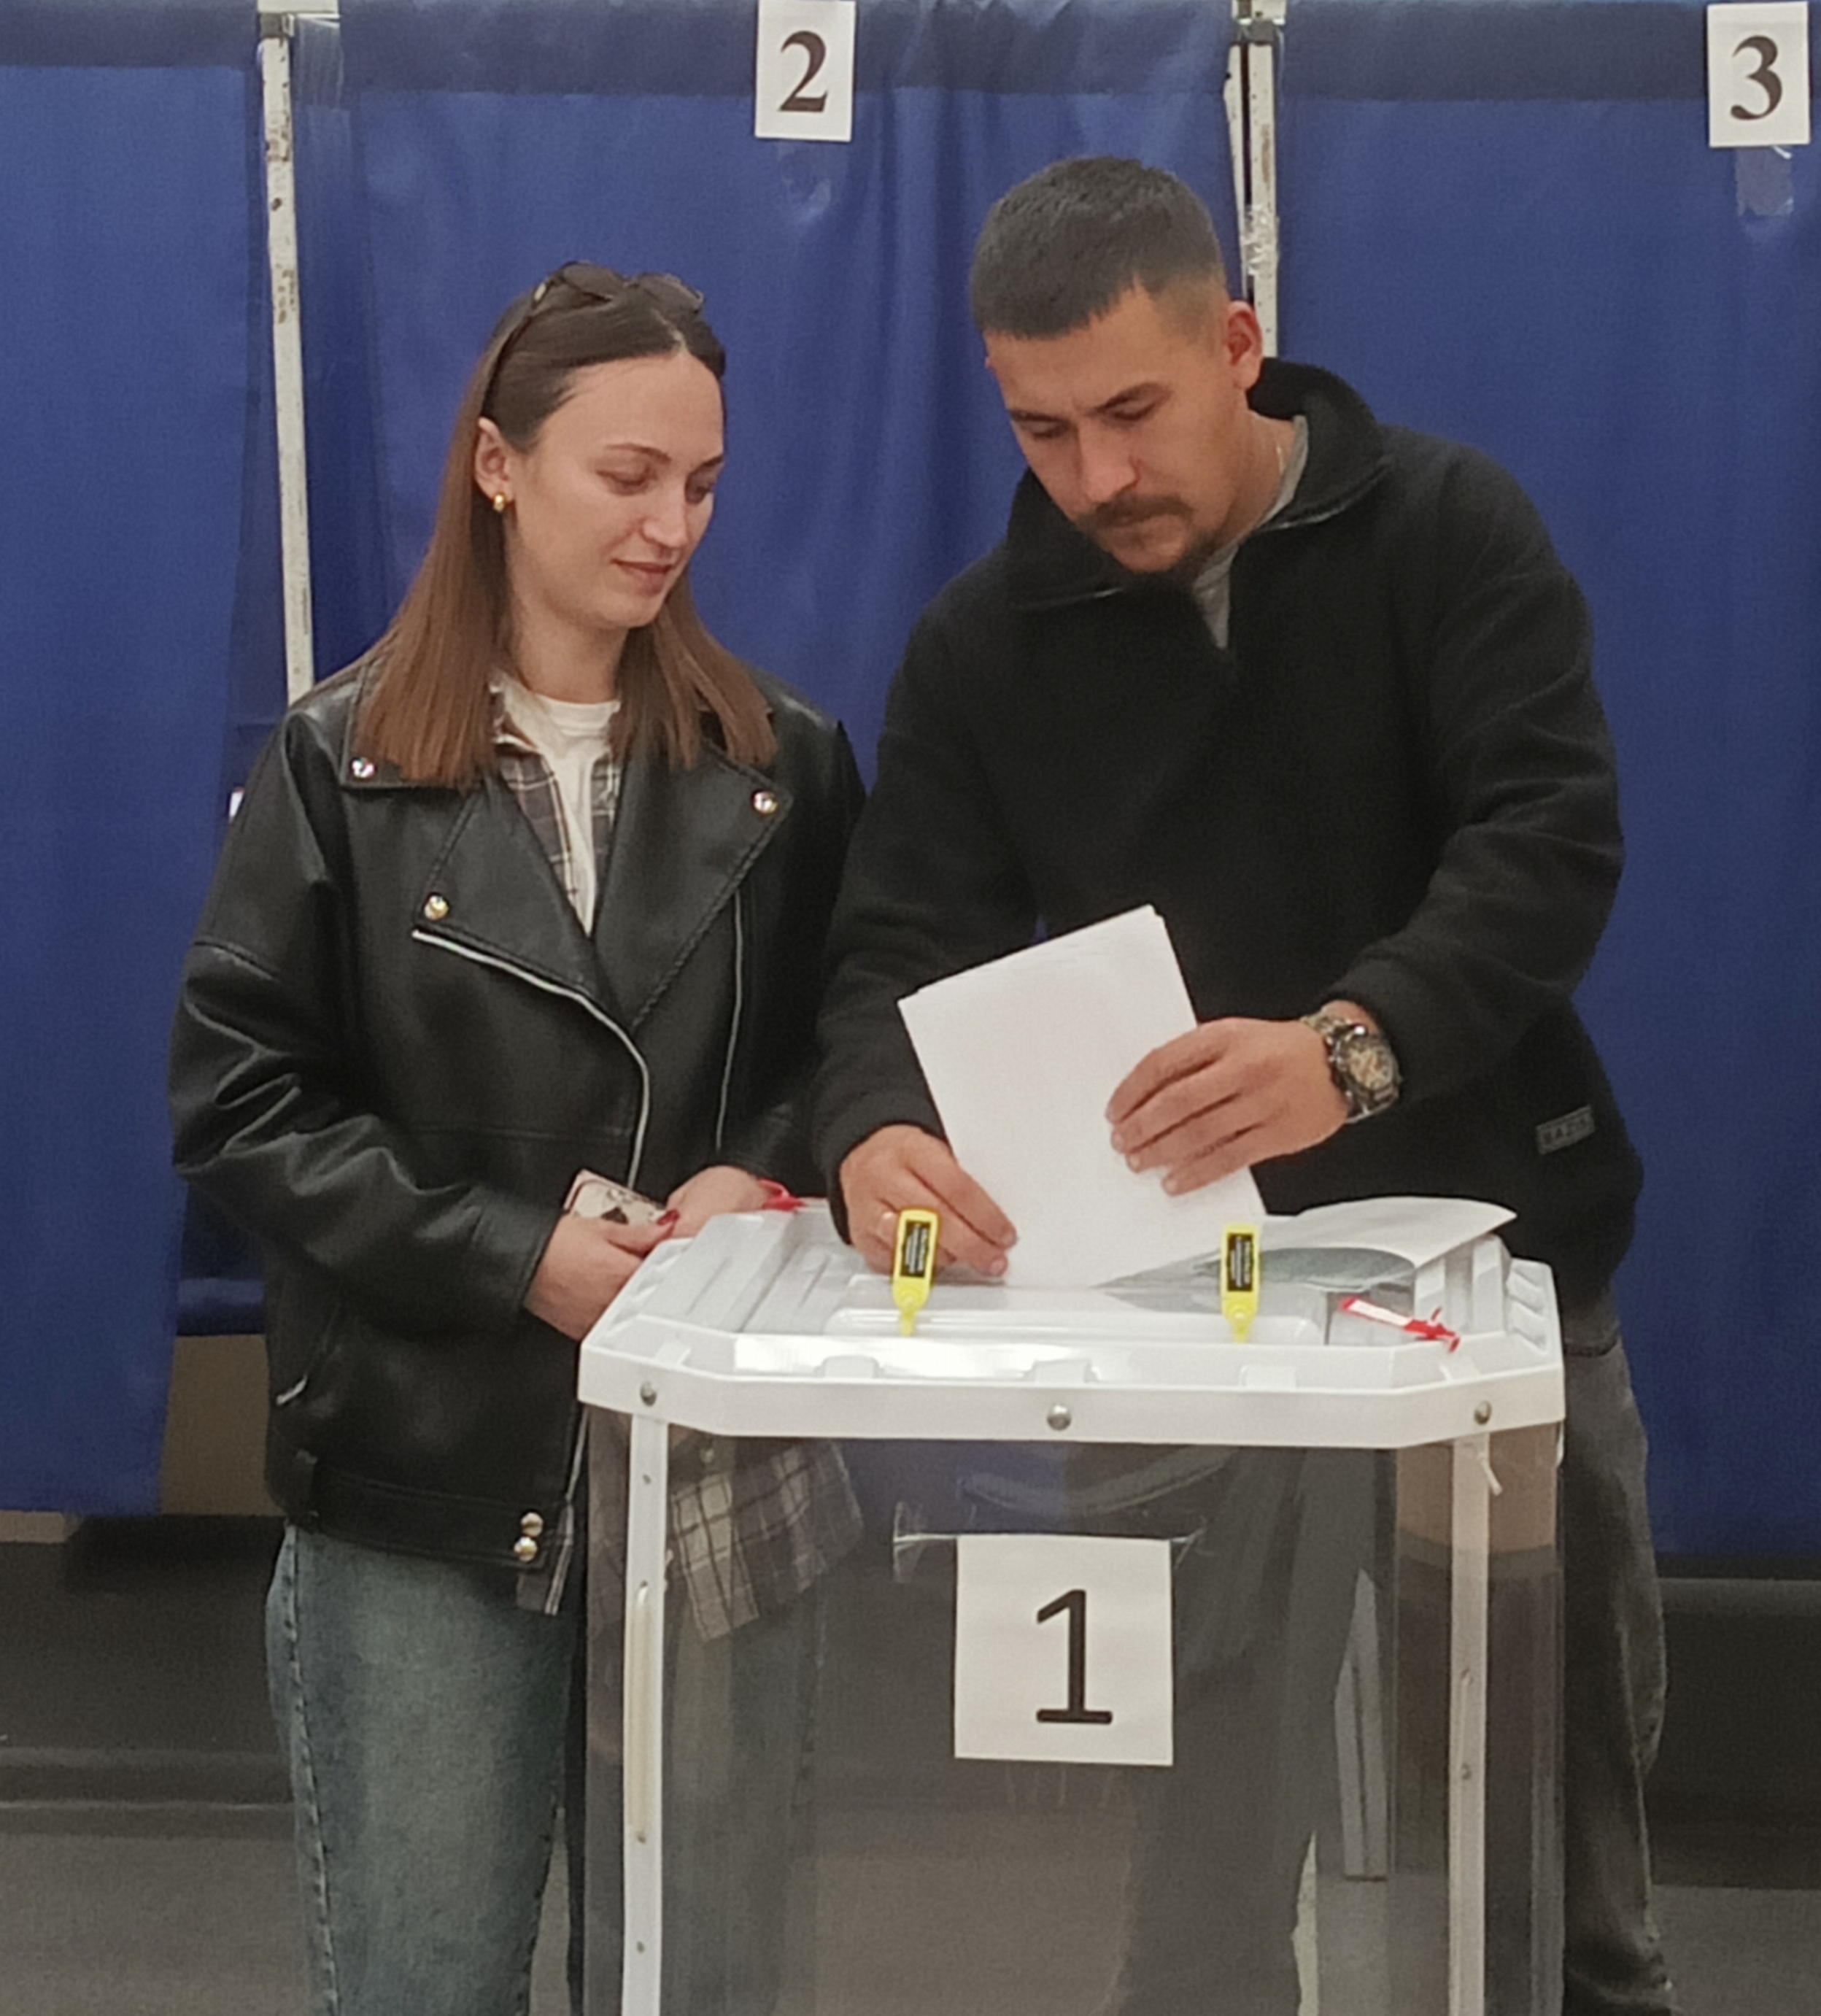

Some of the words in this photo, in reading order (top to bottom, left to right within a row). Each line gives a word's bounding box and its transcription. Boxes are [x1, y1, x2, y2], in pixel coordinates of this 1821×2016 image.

[778, 30, 828, 113] 2
[1730, 35, 1782, 121] 3
[1036, 1588, 1113, 1725] 1
